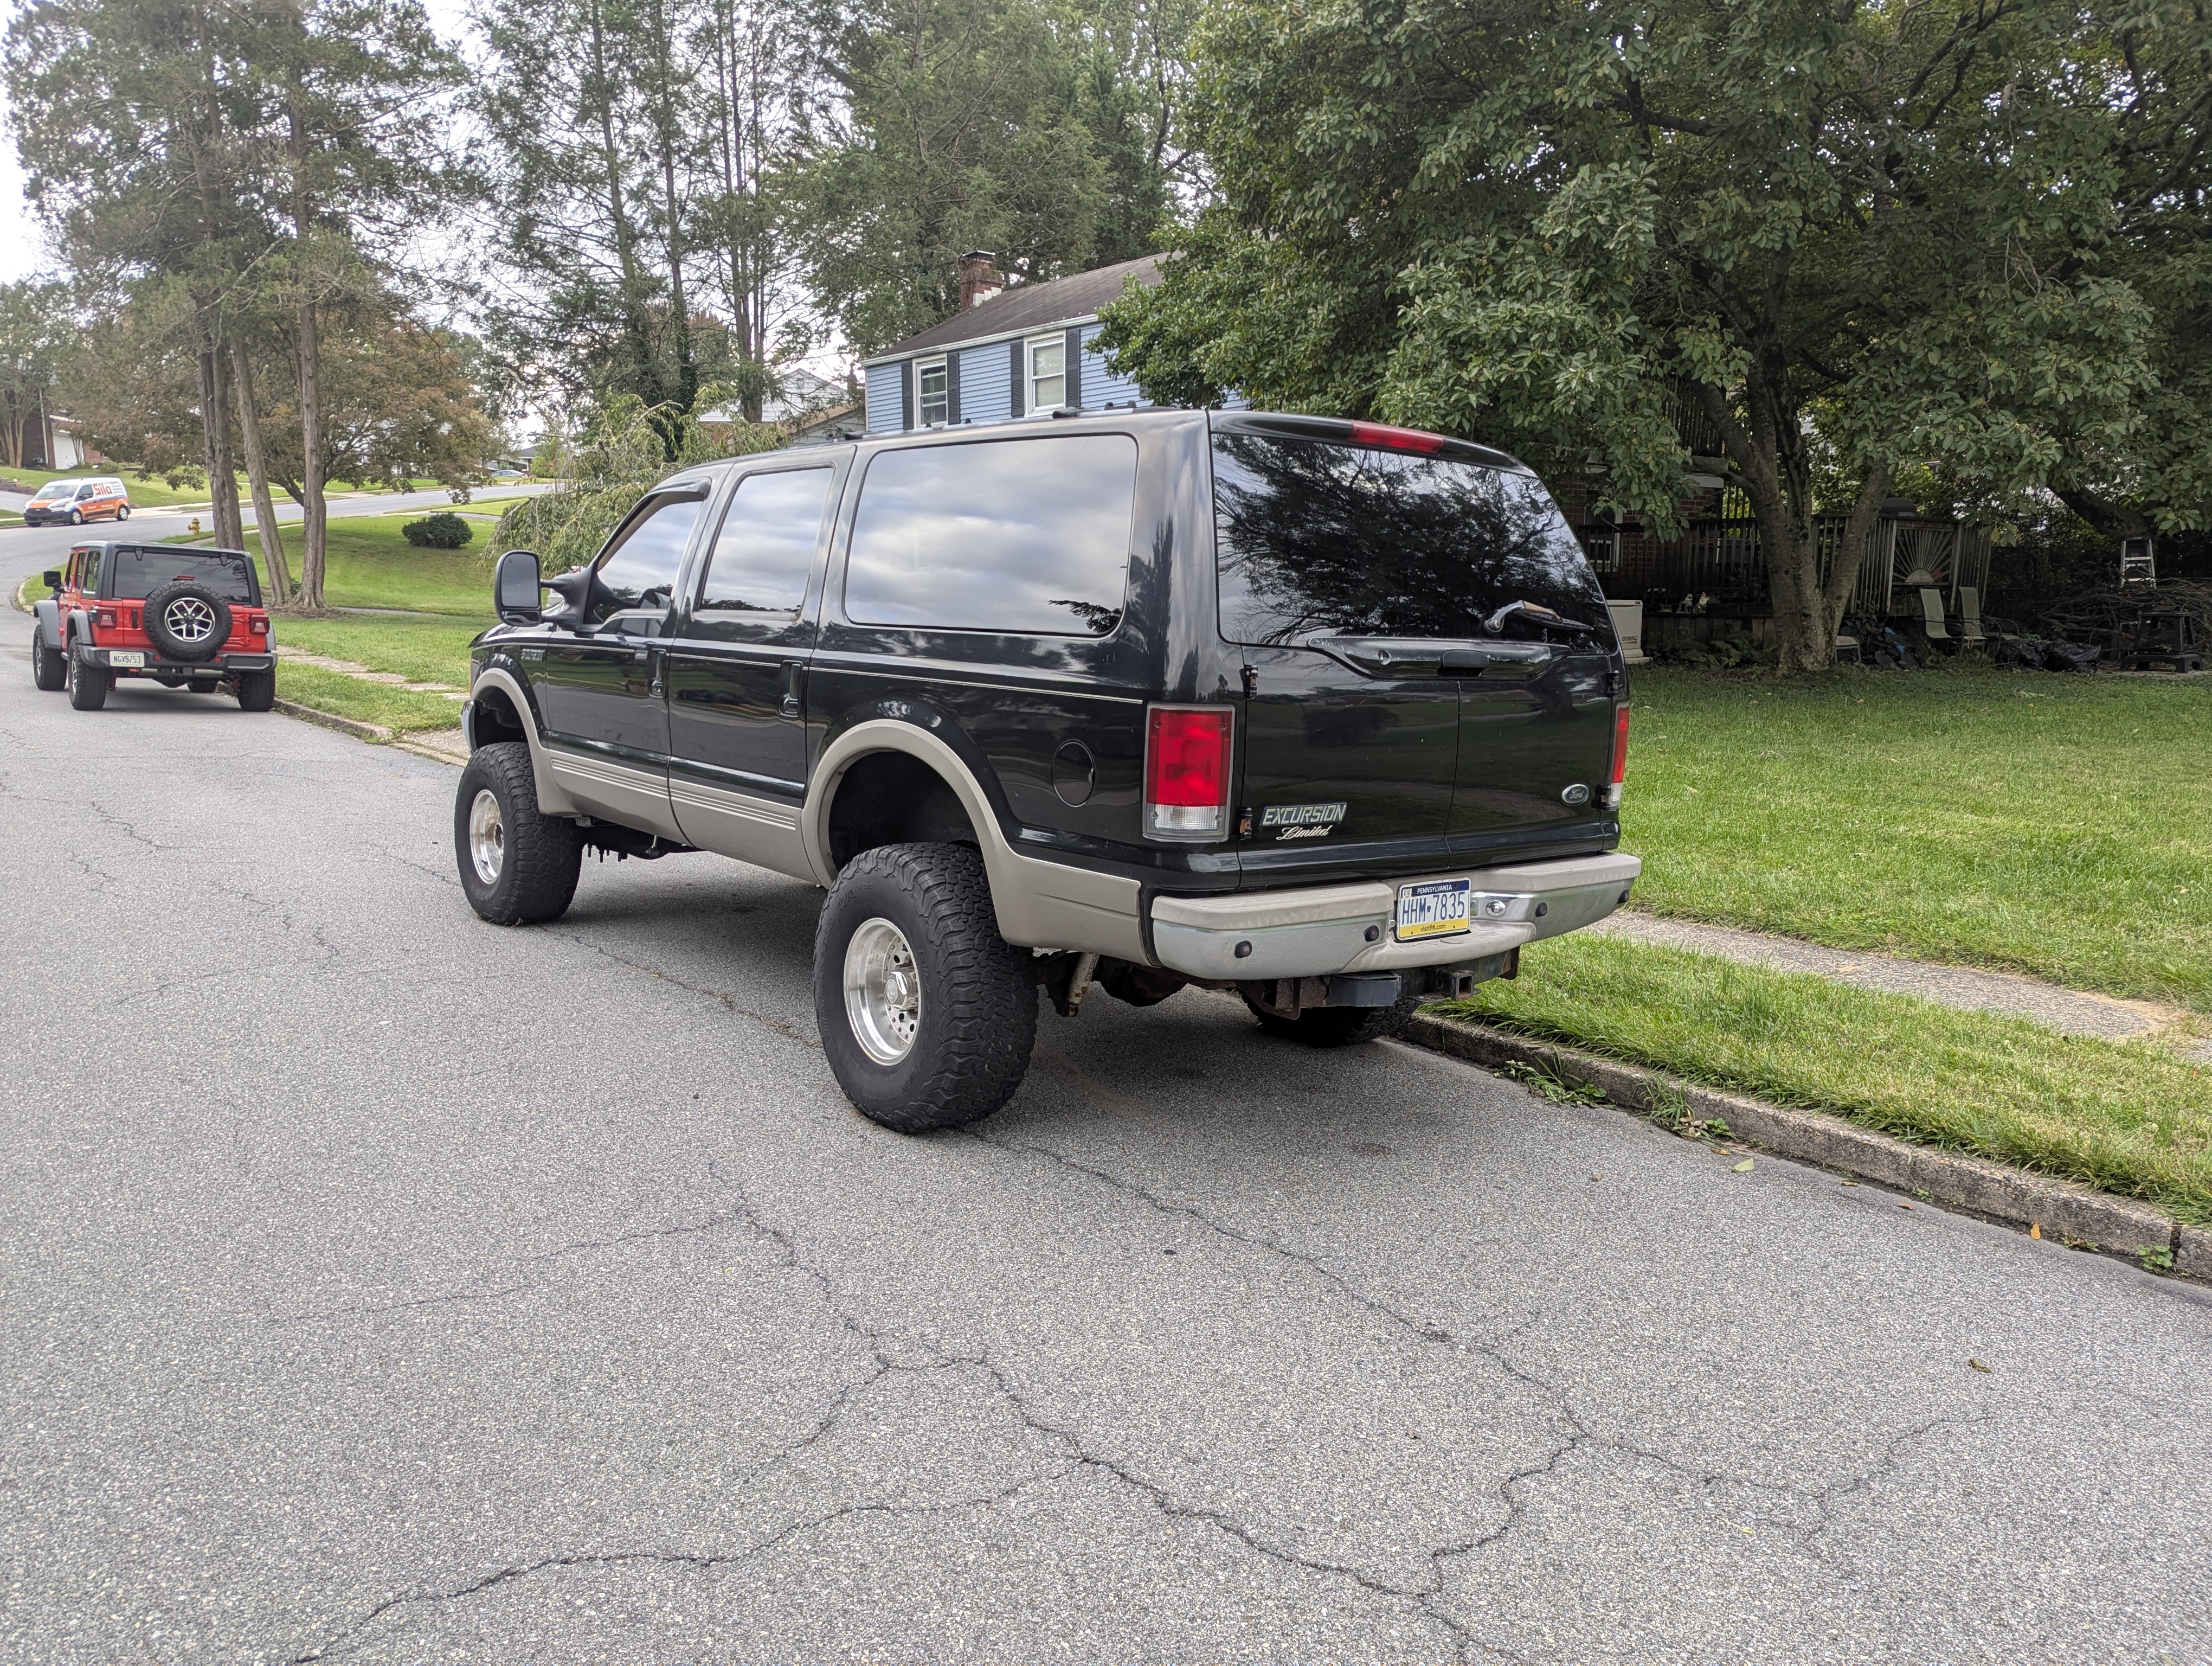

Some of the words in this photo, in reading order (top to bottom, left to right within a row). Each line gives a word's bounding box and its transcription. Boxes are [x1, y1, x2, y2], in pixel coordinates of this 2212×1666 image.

[93, 483, 113, 495] Sila
[113, 655, 141, 663] NGV5753
[1262, 804, 1347, 825] EXCURSION
[1276, 825, 1333, 841] Limited
[1417, 884, 1452, 894] PENNSYLVANIA
[836, 888, 856, 912] T/A
